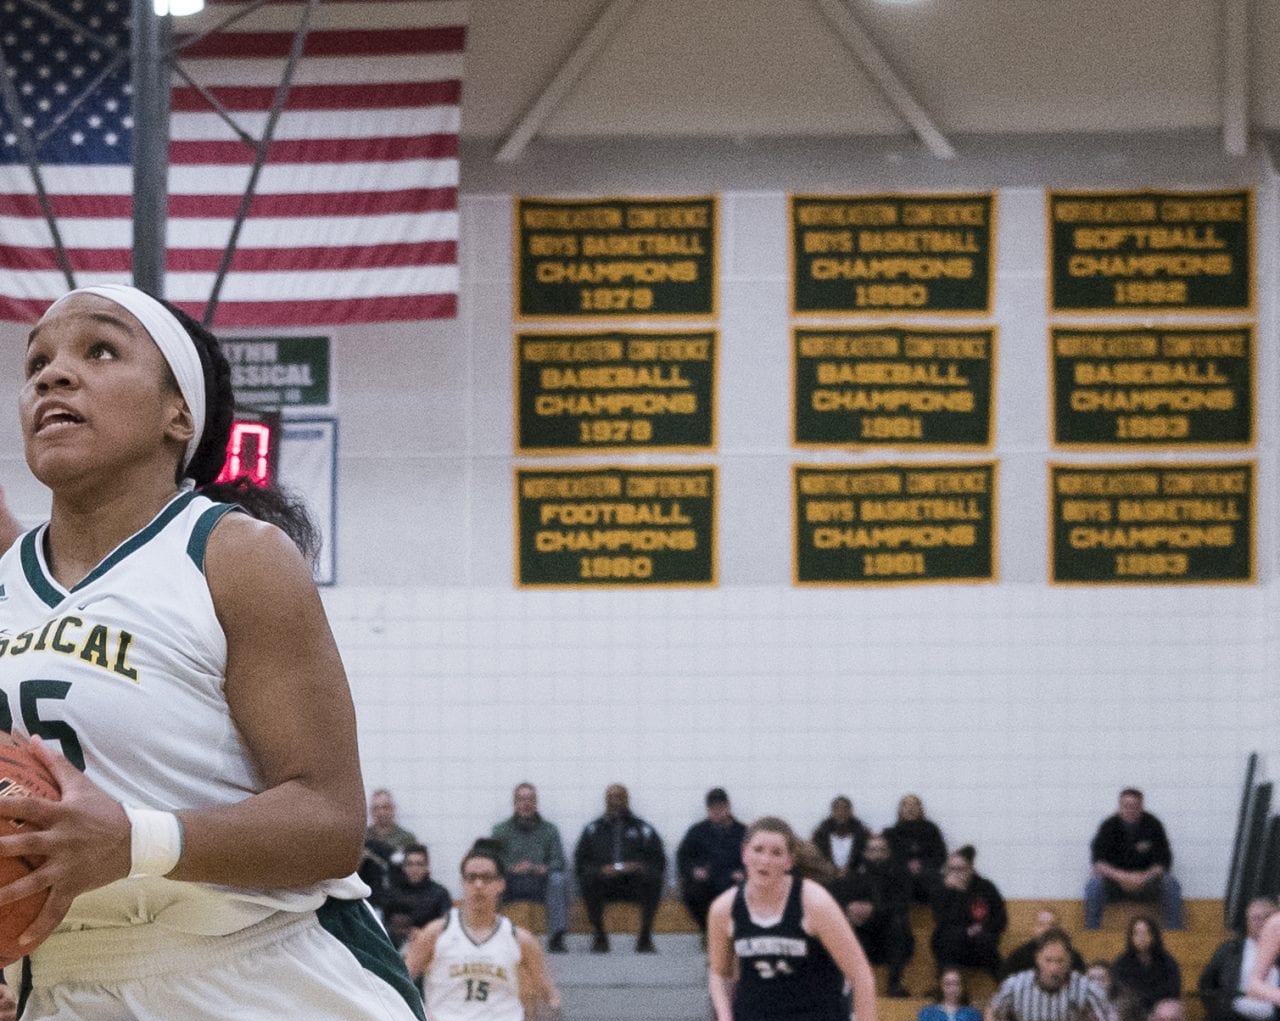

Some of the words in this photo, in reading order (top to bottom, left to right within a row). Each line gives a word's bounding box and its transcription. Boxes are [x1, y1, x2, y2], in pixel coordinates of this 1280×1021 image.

[1074, 228, 1223, 248] SOFTBALL
[538, 262, 697, 281] CHAMPIONS
[811, 259, 973, 278] CHAMPIONS
[1069, 255, 1231, 275] CHAMPIONS
[222, 341, 278, 363] YNN
[231, 363, 314, 387] SSICAL
[542, 367, 692, 388] BASEBALL
[817, 363, 966, 384] BASEBALL
[1074, 363, 1226, 384] BASEBALL
[536, 394, 697, 413] CHAMPIONS
[812, 391, 974, 410] CHAMPIONS
[1071, 390, 1234, 410] CHAMPIONS
[540, 504, 690, 524] FOOTBALL
[535, 530, 696, 550] CHAMPIONS
[813, 527, 975, 547] CHAMPIONS
[1070, 527, 1233, 547] CHAMPIONS
[464, 977, 491, 1003] 15
